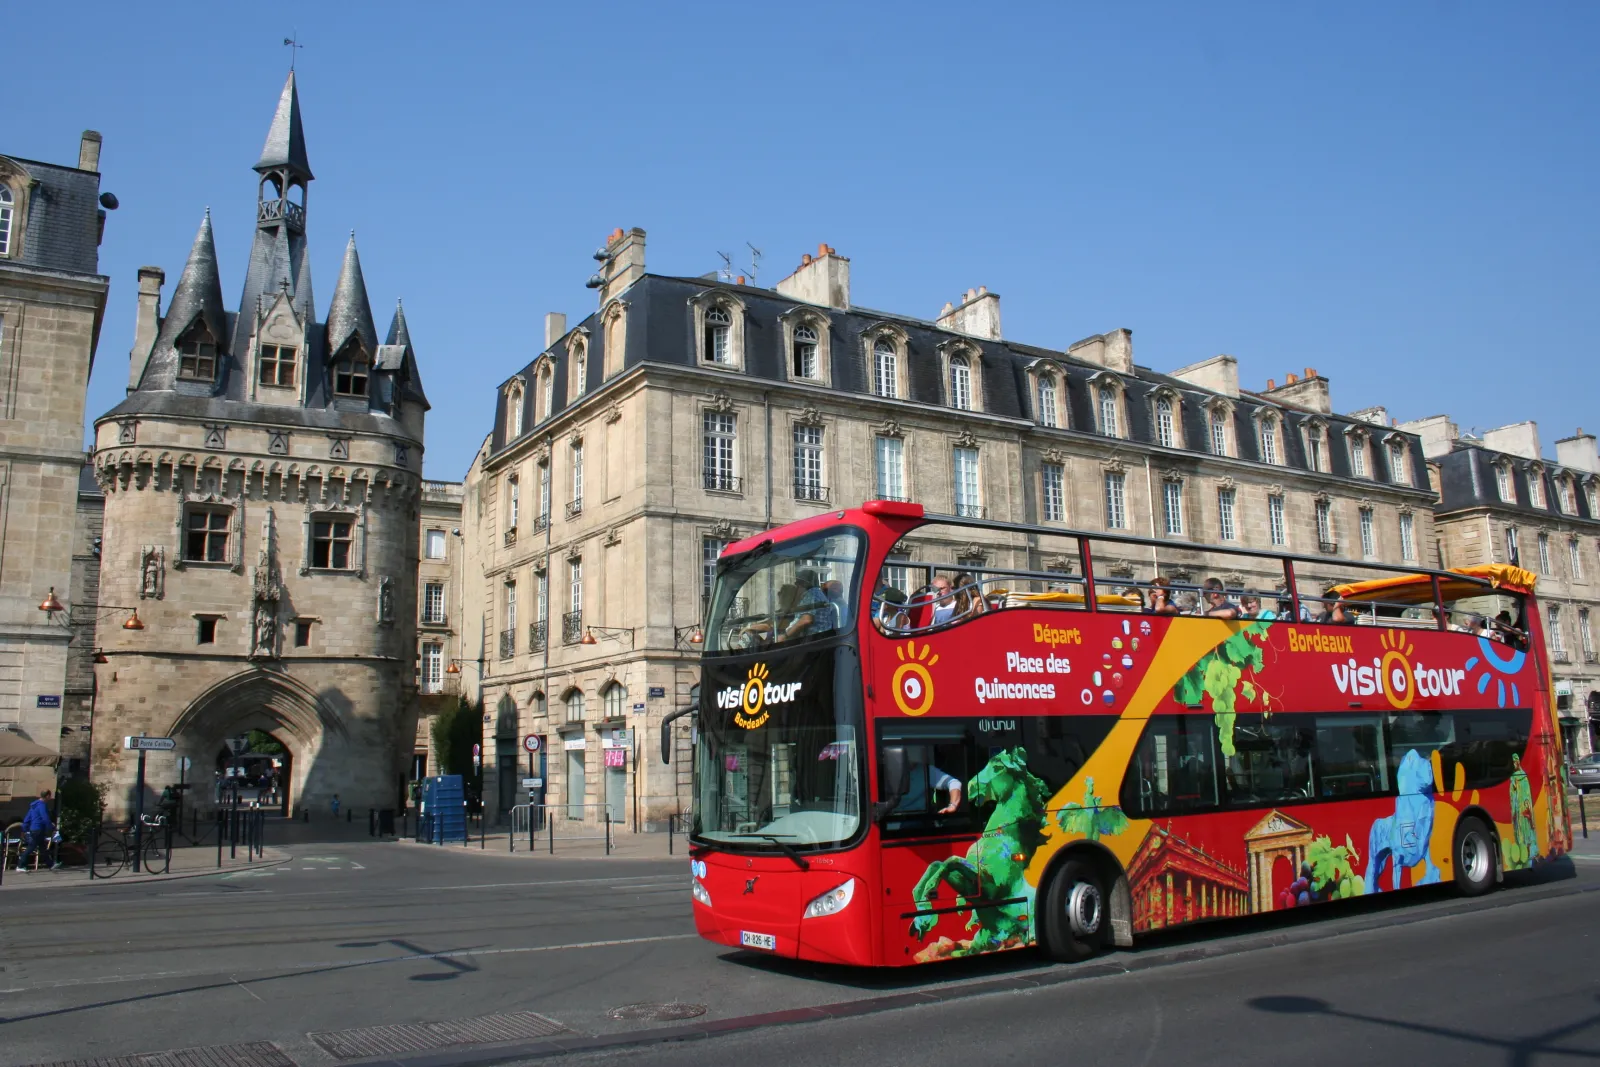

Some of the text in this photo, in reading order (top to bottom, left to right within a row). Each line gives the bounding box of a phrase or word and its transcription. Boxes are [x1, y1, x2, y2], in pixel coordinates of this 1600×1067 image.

[1033, 623, 1081, 648] Départ
[1288, 628, 1354, 653] Bordeaux
[1006, 651, 1071, 674] Place des
[975, 677, 1056, 704] Quinconces
[734, 710, 770, 729] Bordeaux
